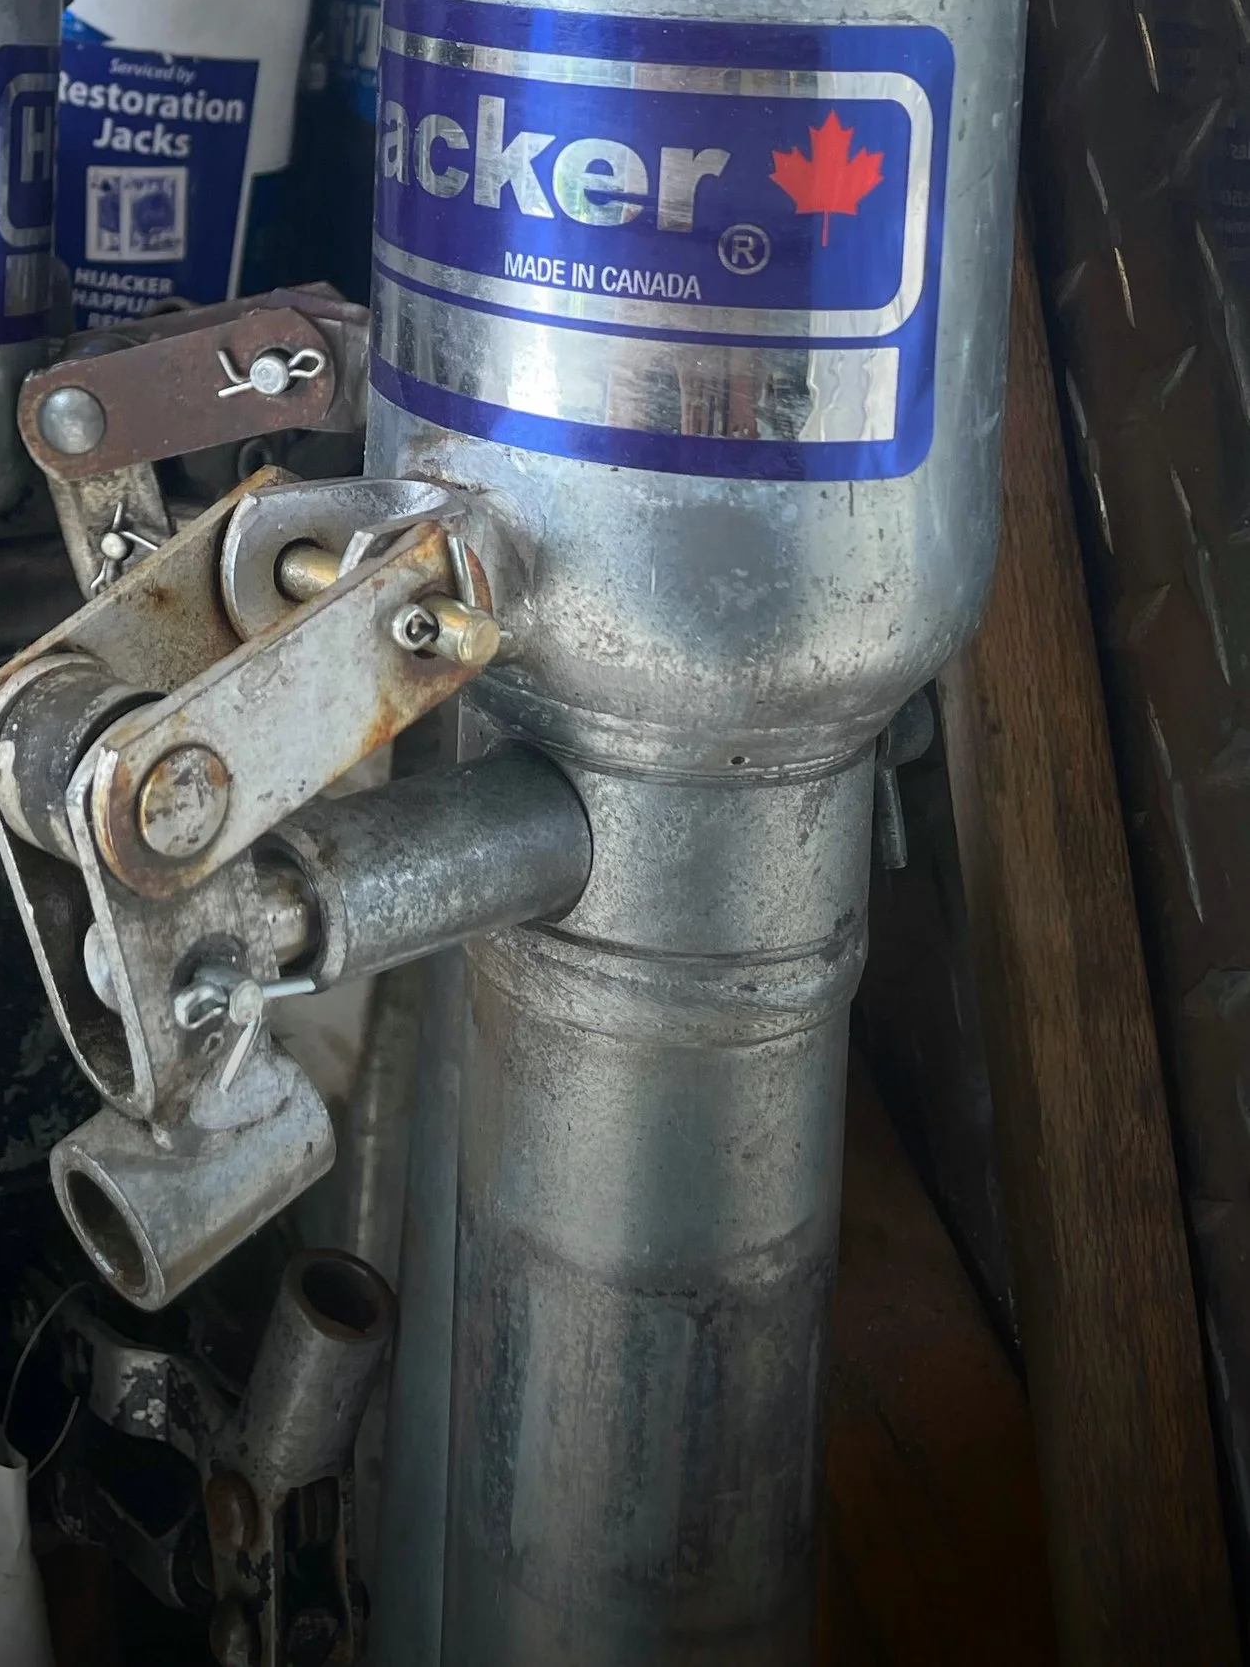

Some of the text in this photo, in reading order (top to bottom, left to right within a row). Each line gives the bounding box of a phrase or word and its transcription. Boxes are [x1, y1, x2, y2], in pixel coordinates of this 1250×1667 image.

[93, 118, 192, 158] Jacks
[381, 95, 731, 233] acker
[504, 250, 702, 300] MADE IN CANADA
